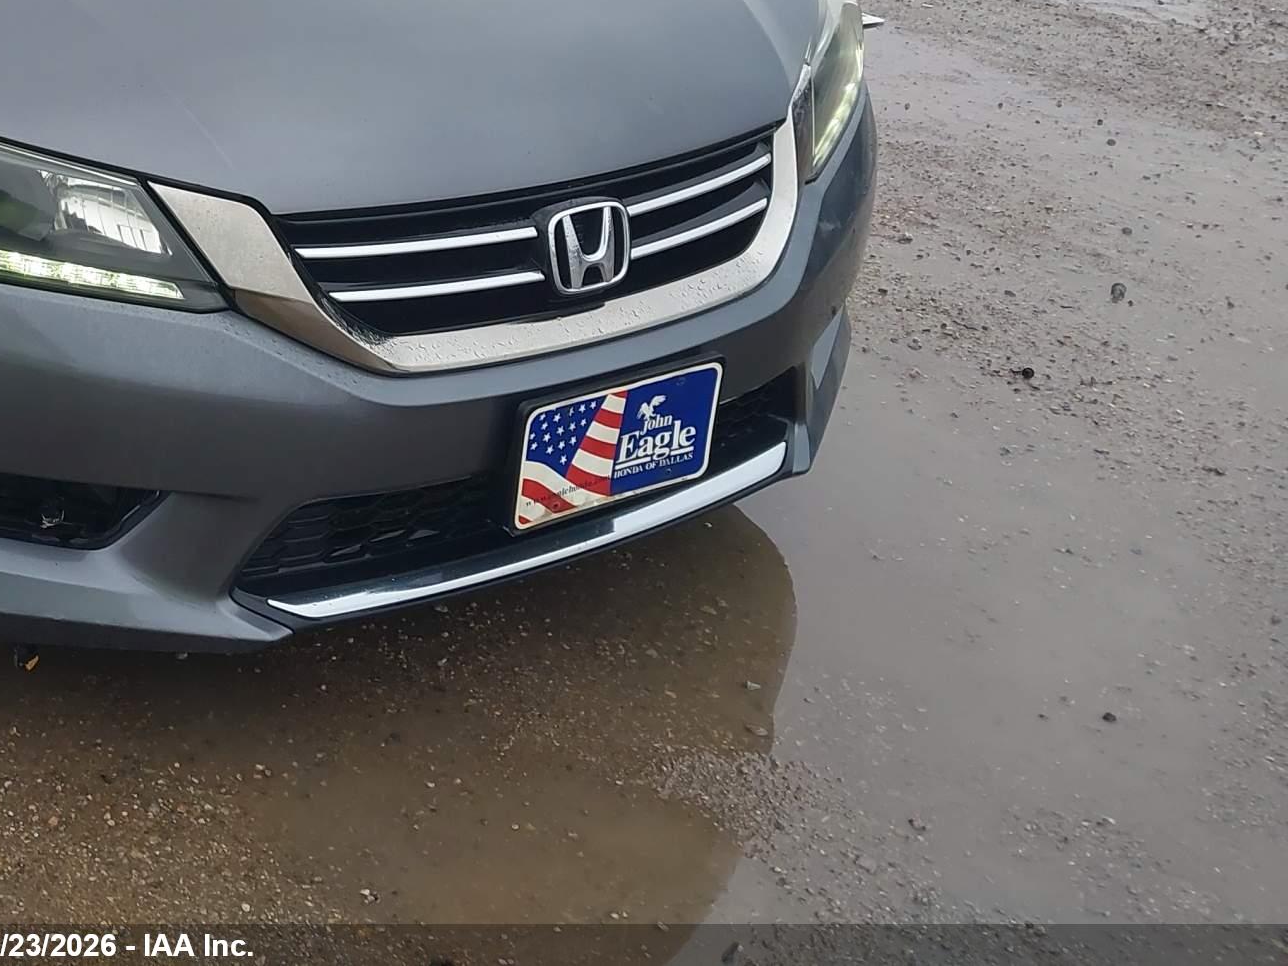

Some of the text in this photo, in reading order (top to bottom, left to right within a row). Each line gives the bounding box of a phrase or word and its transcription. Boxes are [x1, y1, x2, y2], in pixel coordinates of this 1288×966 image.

[615, 419, 697, 461] Eagle
[614, 452, 694, 479] HONDA OF DALLAS
